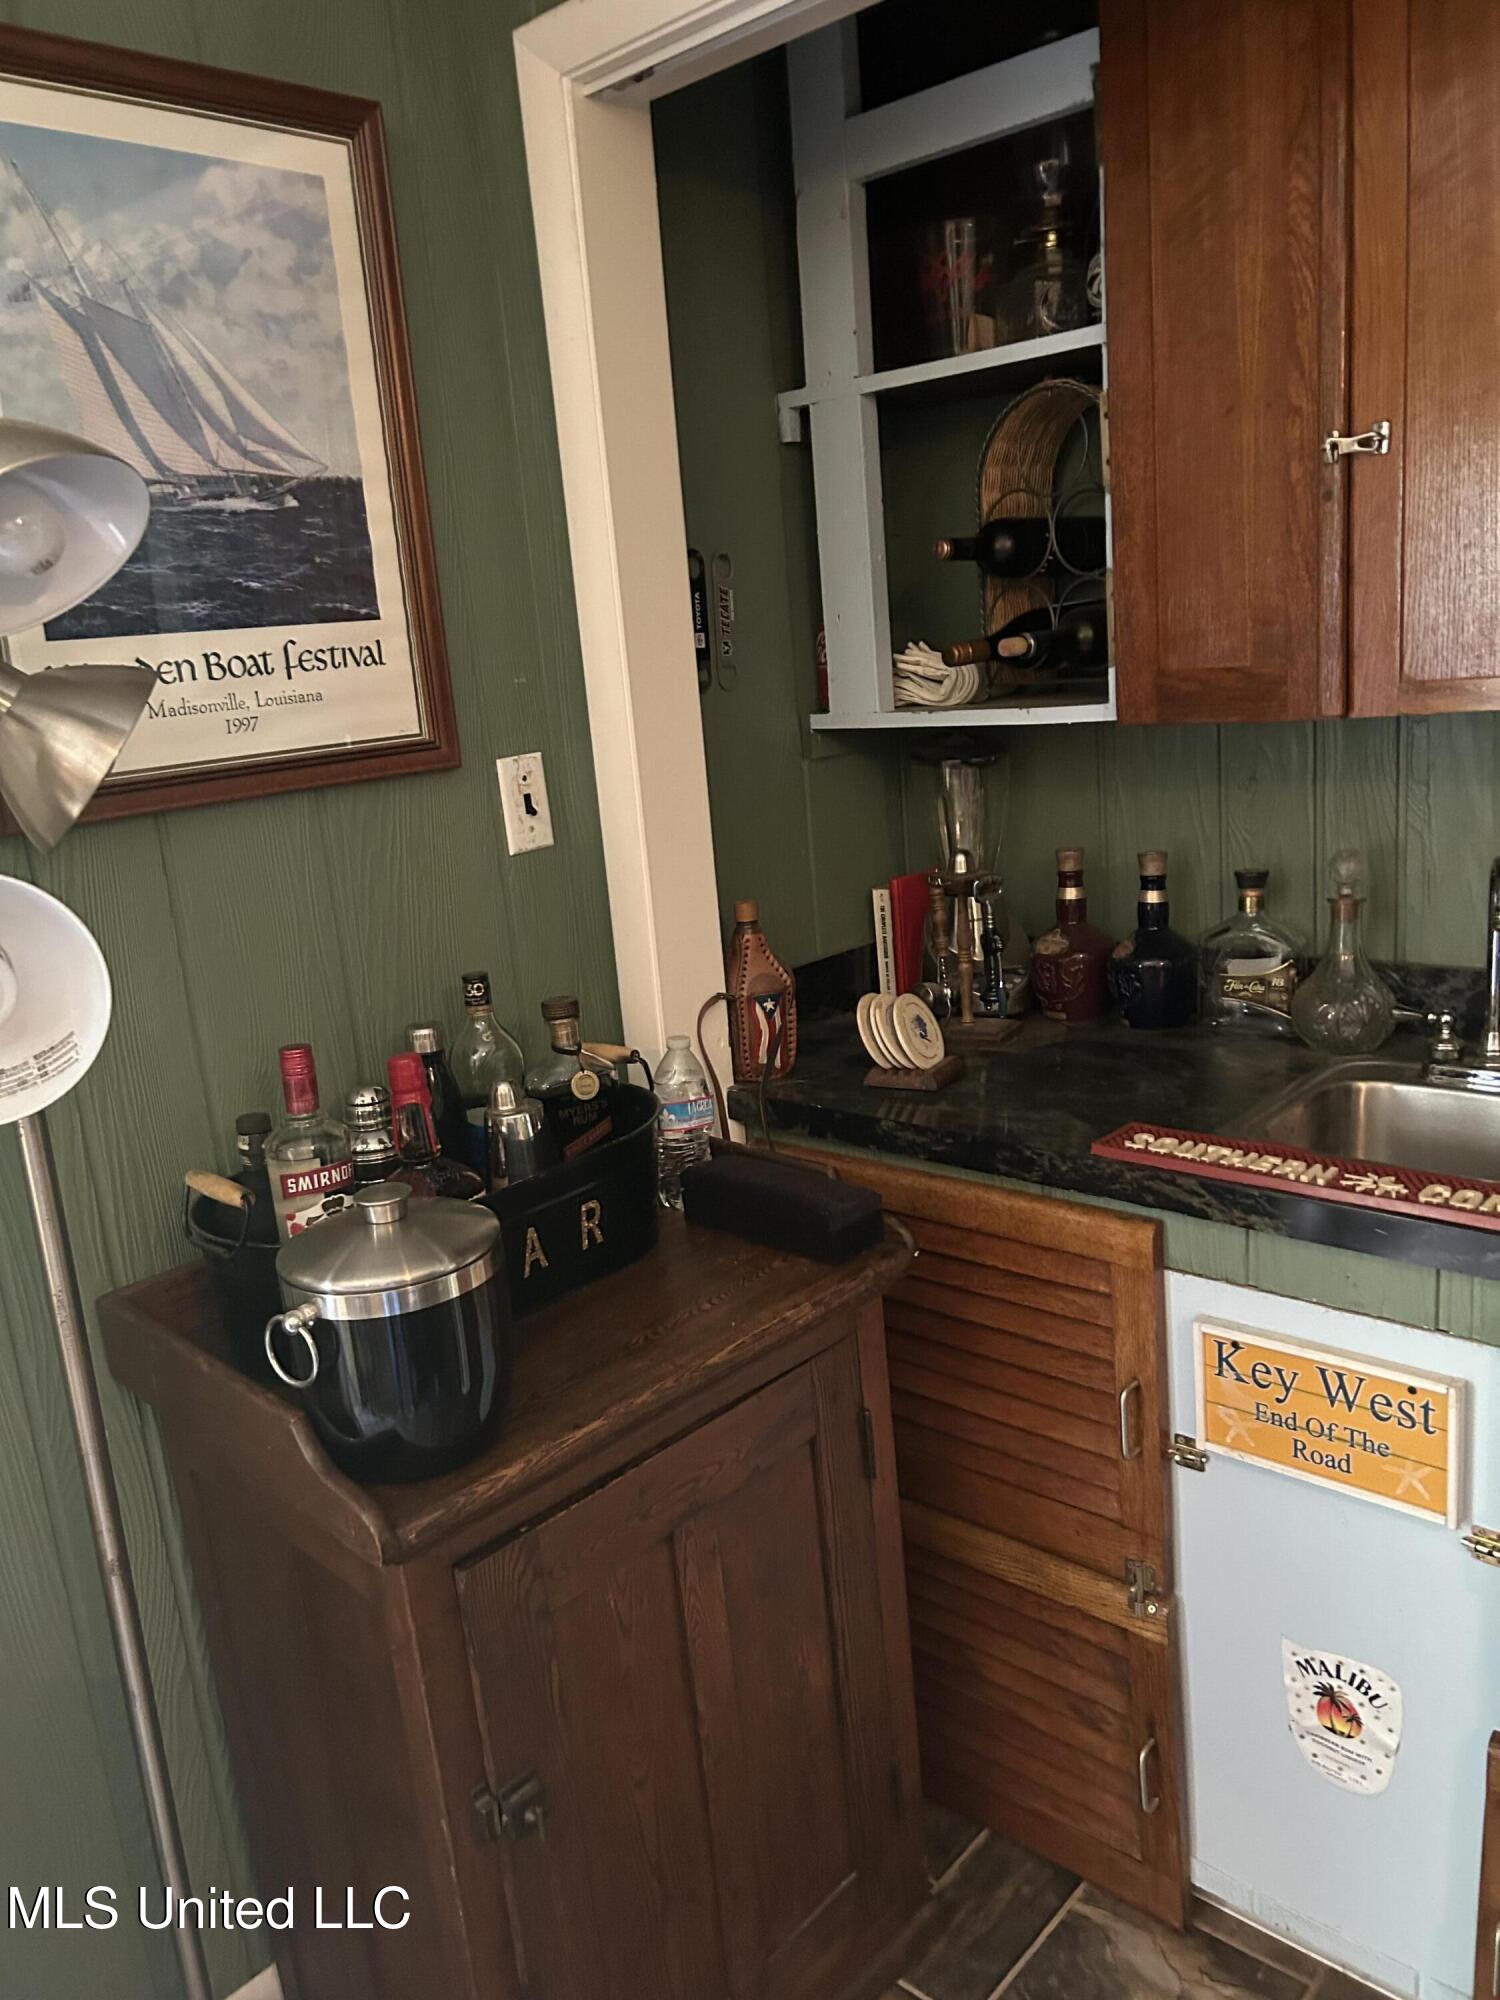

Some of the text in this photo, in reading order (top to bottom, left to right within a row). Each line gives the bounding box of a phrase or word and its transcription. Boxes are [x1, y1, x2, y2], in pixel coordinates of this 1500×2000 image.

[694, 592, 703, 630] TOYOTA
[719, 586, 730, 636] TECATE
[202, 650, 275, 681] Boat
[147, 690, 324, 719] Madisonville, Louisiana
[225, 716, 259, 735] 1997
[1124, 1132, 1339, 1186] SOUTHERN
[1213, 1338, 1438, 1436] Key West
[1254, 1401, 1391, 1457] End Of The
[1291, 1438, 1354, 1475] Road
[1295, 1657, 1389, 1711] MALIBU
